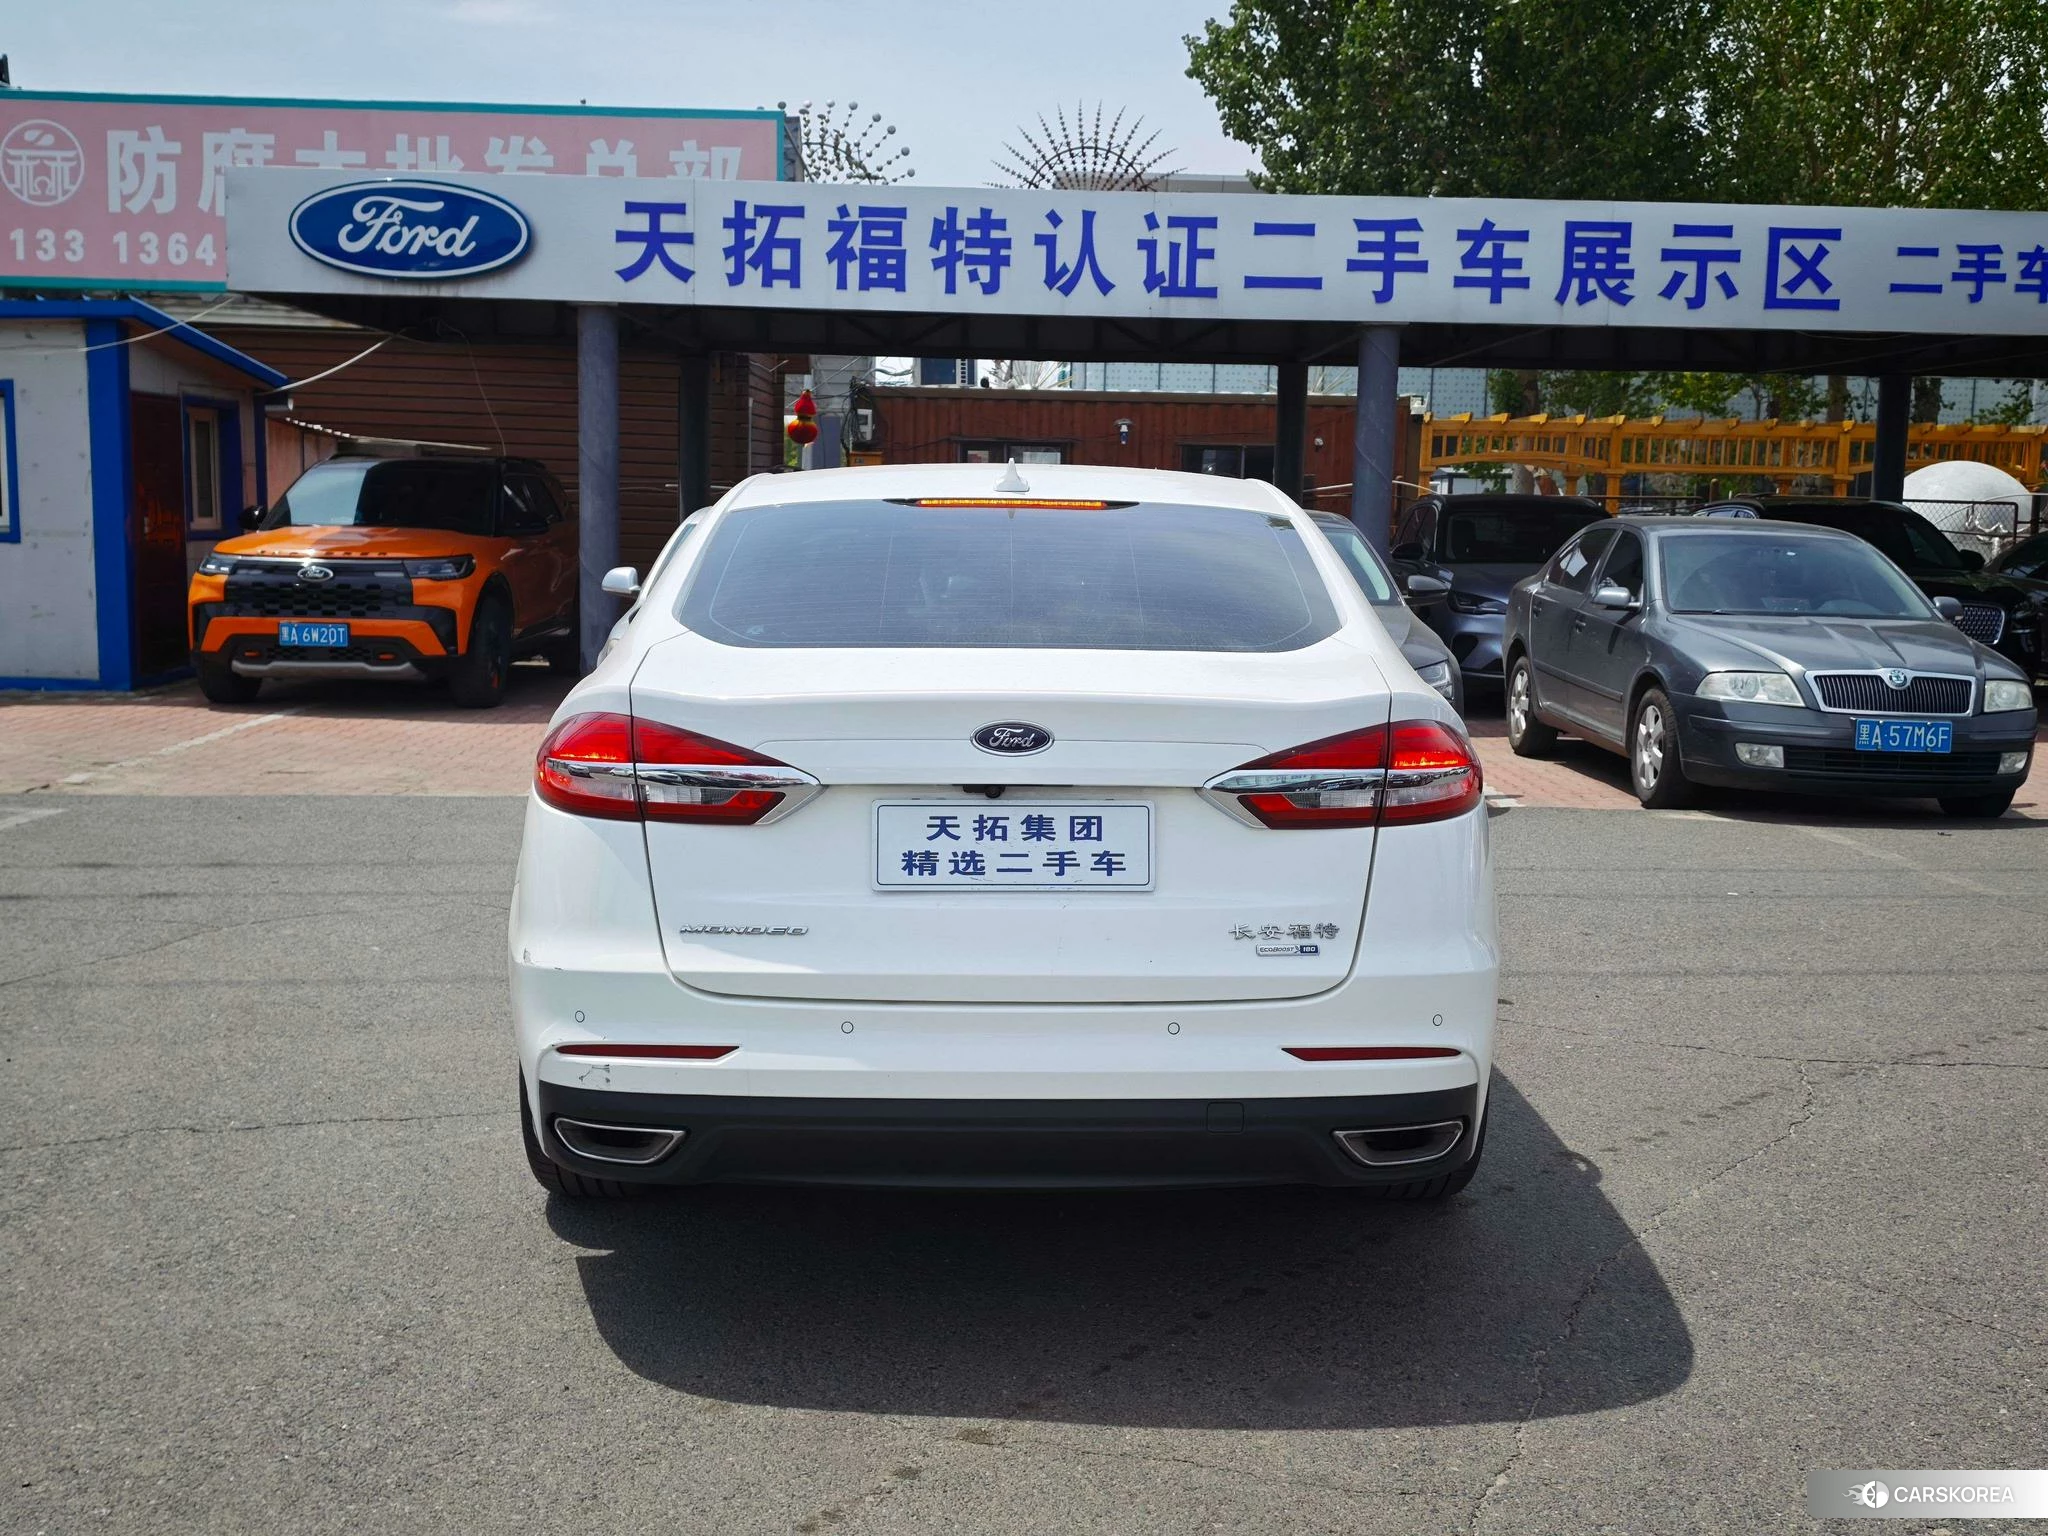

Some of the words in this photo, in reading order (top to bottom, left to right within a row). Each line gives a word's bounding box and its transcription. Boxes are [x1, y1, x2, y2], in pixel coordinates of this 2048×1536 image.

[338, 195, 480, 257] Ford
[9, 228, 85, 262] 133
[112, 231, 217, 266] 1364
[615, 200, 1843, 311] 天拓福特认证二手车展示区
[1889, 244, 2048, 304] 二手车
[989, 727, 1035, 747] Ford
[926, 814, 1103, 841] 天拓集团
[901, 850, 1127, 876] 精选二手车
[679, 924, 809, 936] MONDEO
[1228, 922, 1341, 940] 长安福特
